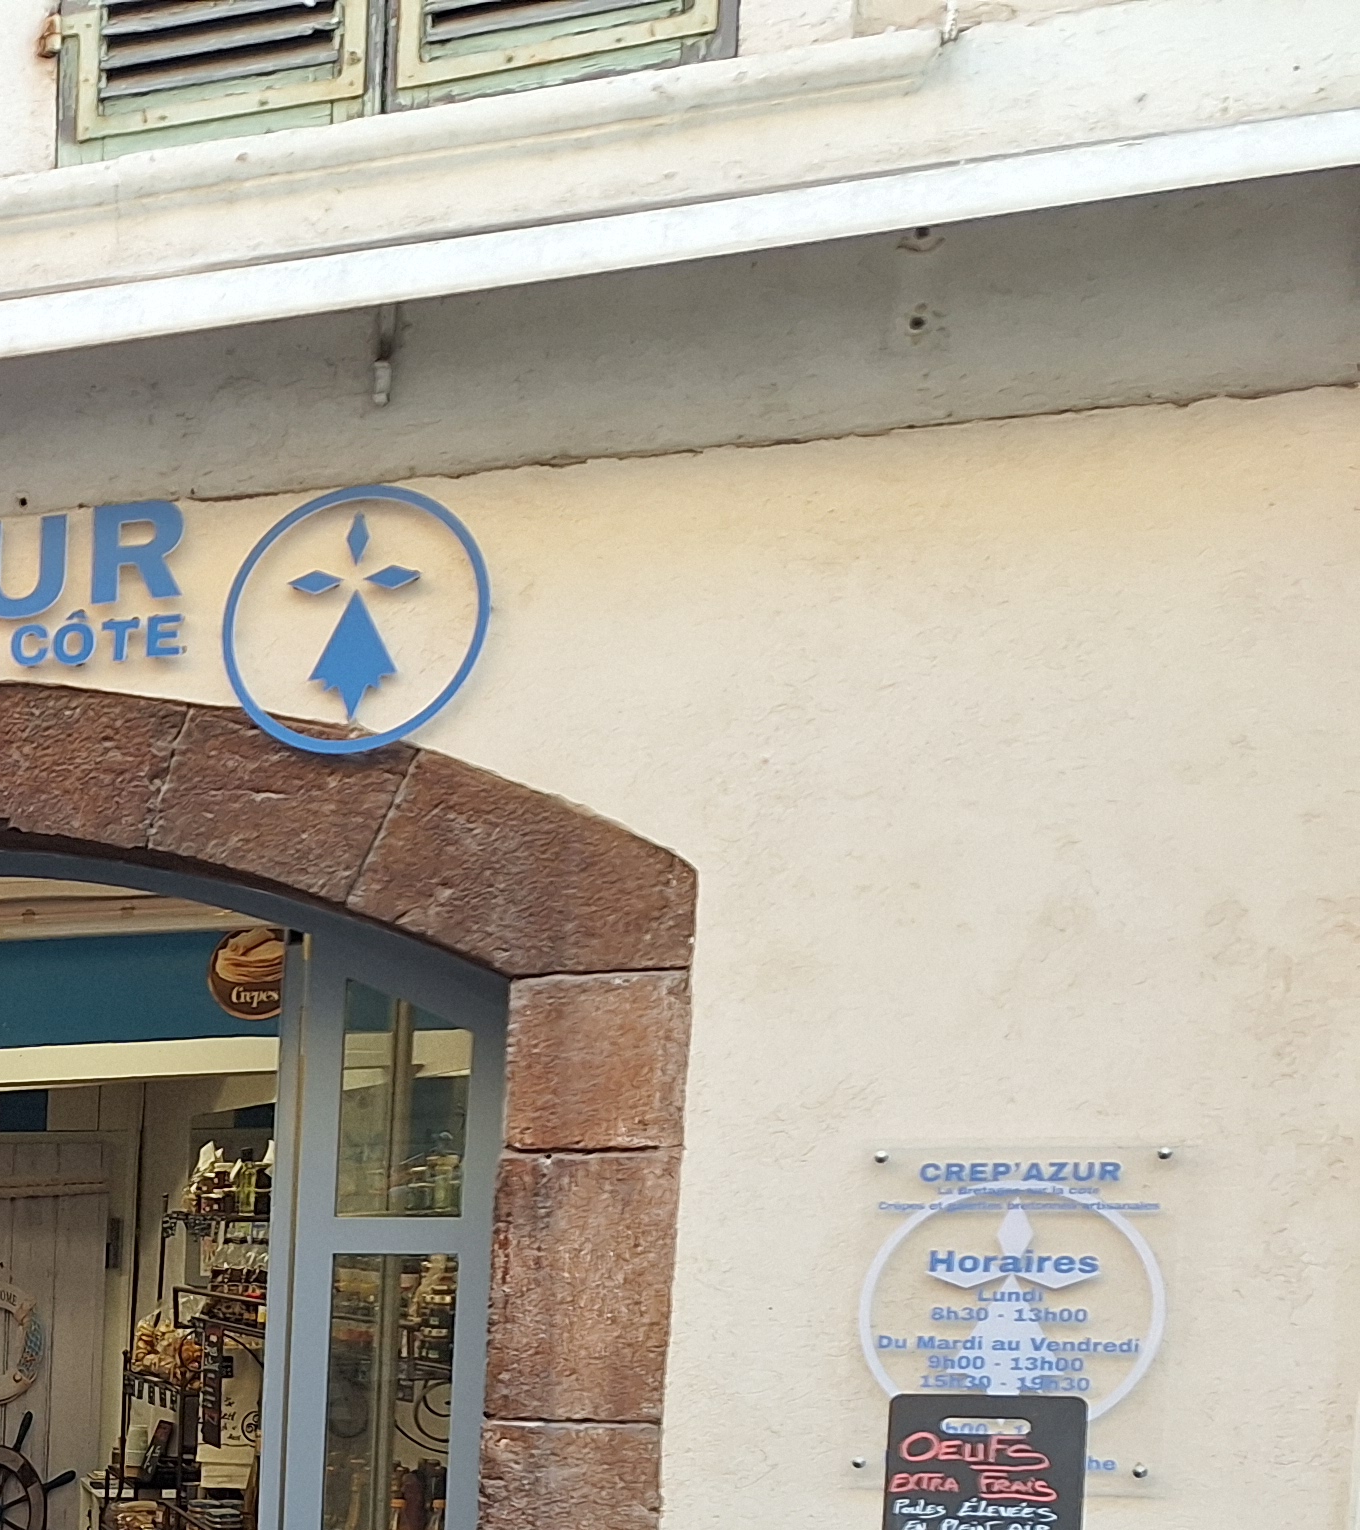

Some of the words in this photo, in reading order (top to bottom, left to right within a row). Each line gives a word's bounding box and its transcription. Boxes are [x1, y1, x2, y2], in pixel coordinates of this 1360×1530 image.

[10, 610, 182, 667] CÔTE
[919, 1161, 1121, 1183] CREP'AZUR
[929, 1250, 1100, 1274] Horaires
[978, 1289, 1044, 1303] Lundi
[931, 1307, 989, 1322] 8h30
[1013, 1308, 1088, 1323] 13h00
[877, 1335, 907, 1350] Du
[917, 1335, 983, 1351] Mardi
[992, 1340, 1020, 1352] au
[1031, 1337, 1140, 1353] Vendredi
[928, 1355, 986, 1371] 9h00
[1010, 1357, 1084, 1373] 13h00
[919, 1375, 991, 1391] 15h30
[1016, 1376, 1091, 1392] 19h30
